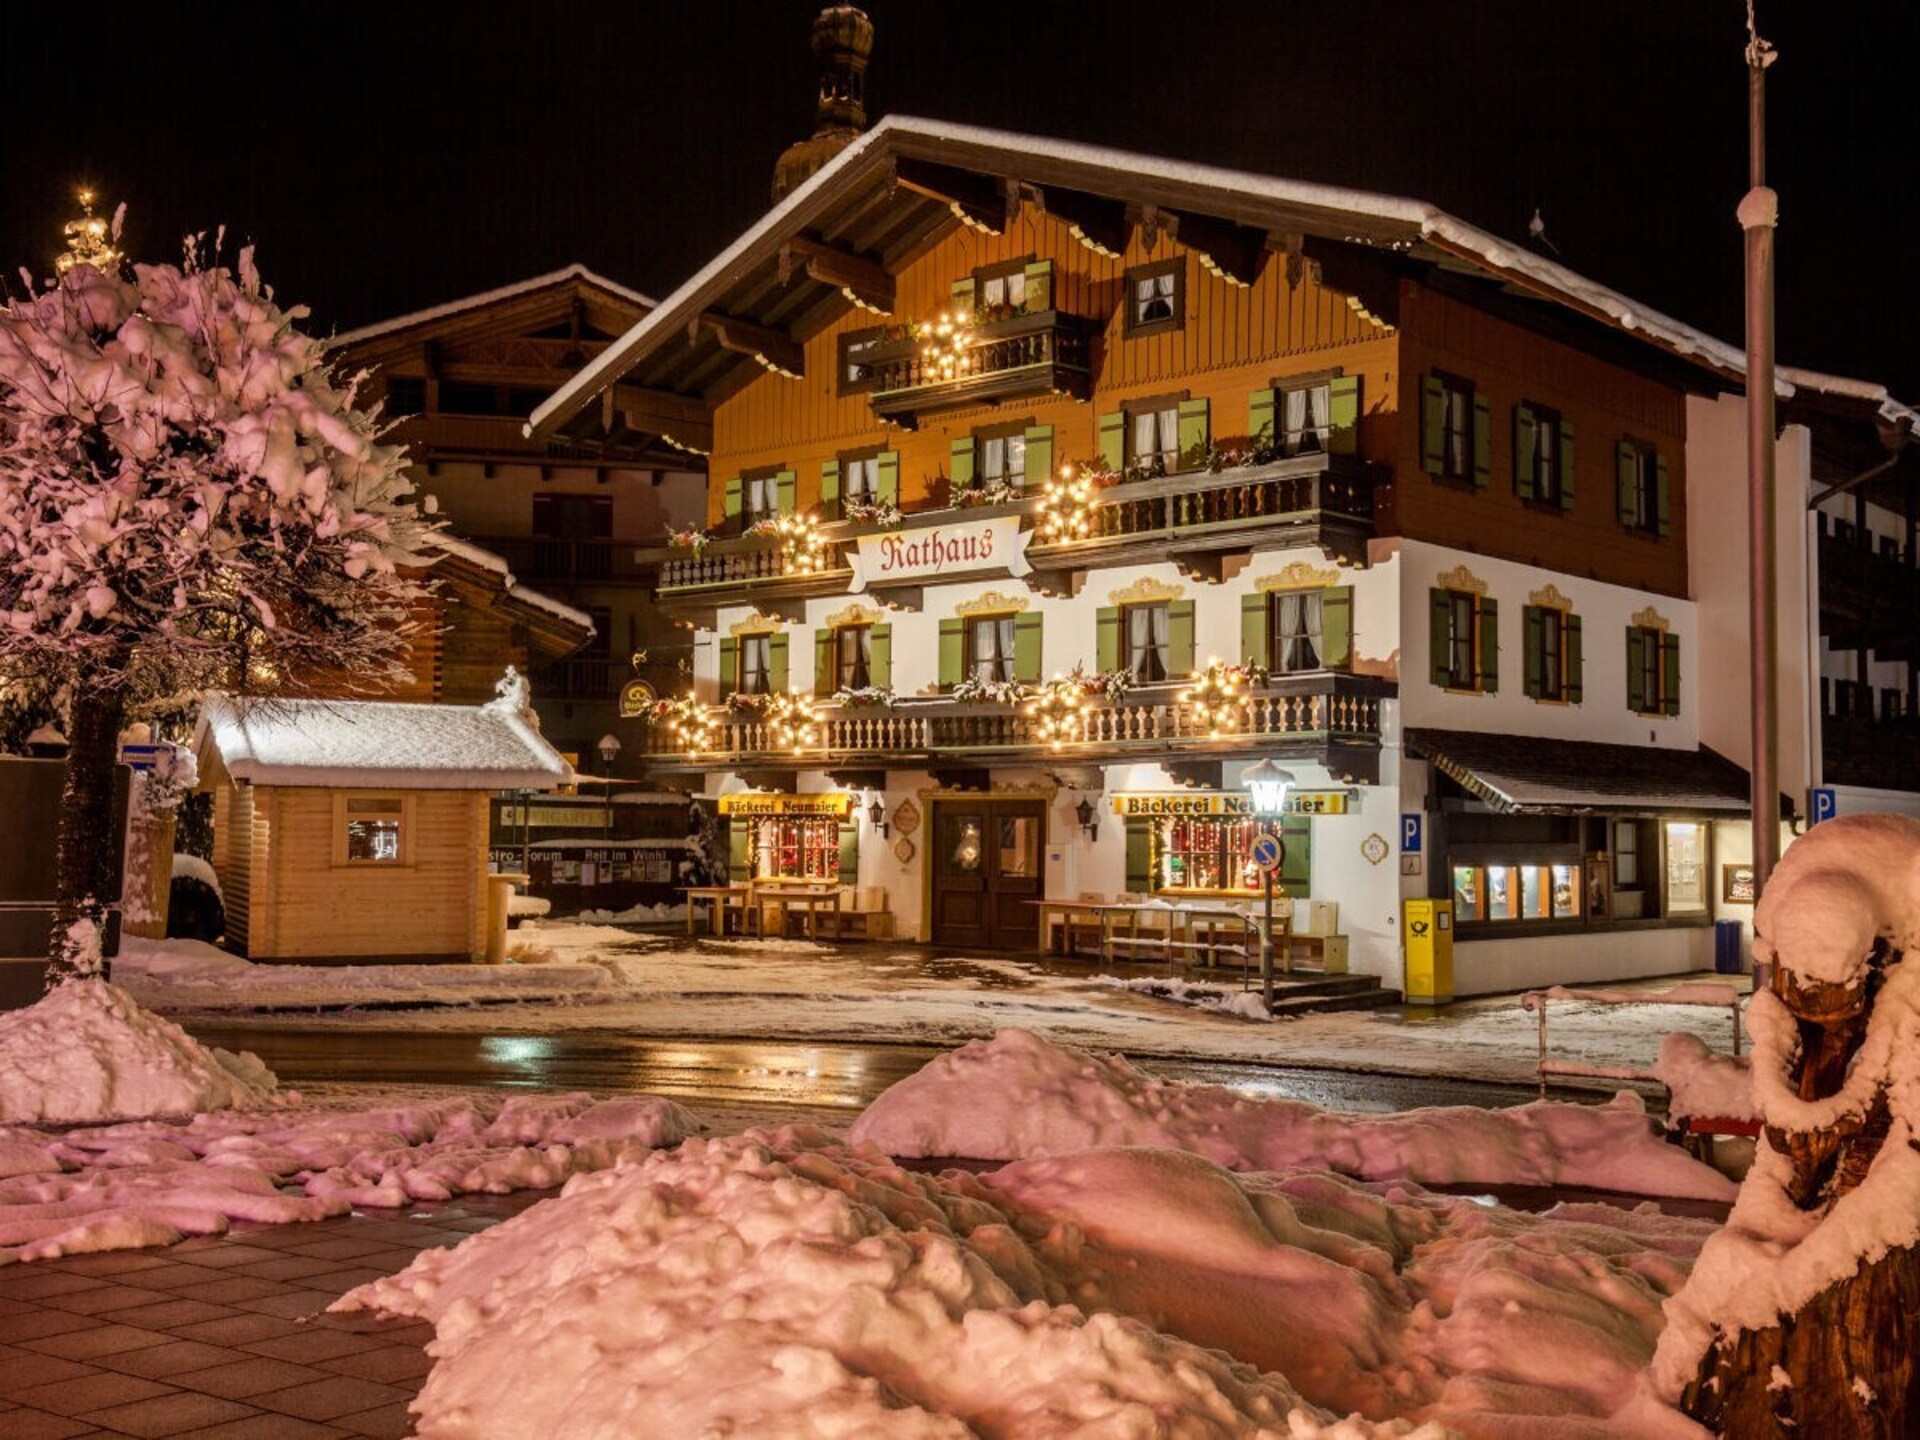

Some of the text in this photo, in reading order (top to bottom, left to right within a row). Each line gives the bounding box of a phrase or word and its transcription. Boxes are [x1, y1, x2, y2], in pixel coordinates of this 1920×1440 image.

[881, 529, 993, 572] Rathaus
[782, 800, 837, 812] Neumaier
[1127, 797, 1324, 814] Bäckerei Neaier
[1818, 793, 1830, 822] P
[1405, 818, 1417, 848] P
